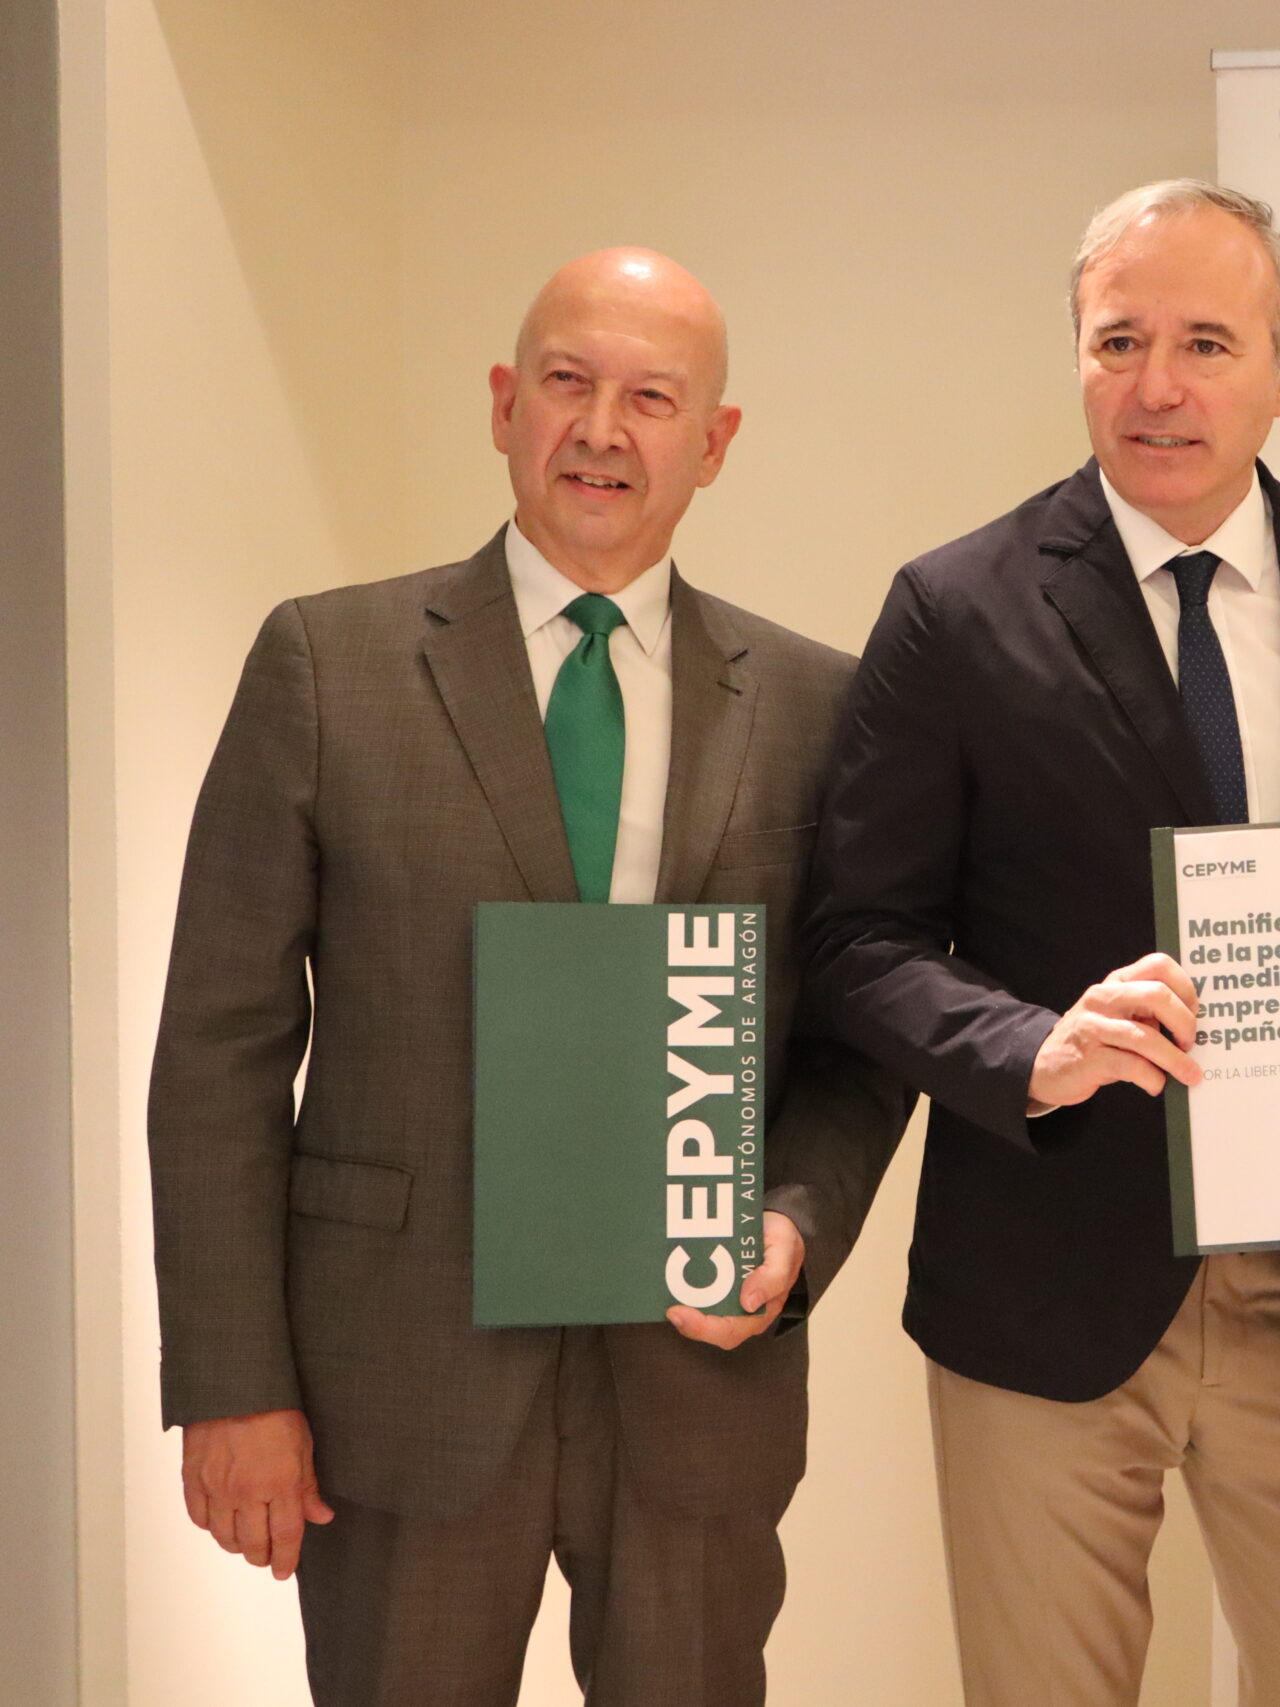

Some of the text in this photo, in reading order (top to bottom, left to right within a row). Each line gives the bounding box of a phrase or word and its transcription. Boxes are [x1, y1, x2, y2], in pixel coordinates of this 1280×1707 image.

[1182, 859, 1256, 878] CEPYME
[1190, 945, 1221, 965] de
[1228, 943, 1251, 962] la
[1191, 975, 1207, 997] y
[1203, 1069, 1221, 1081] OR
[1226, 1067, 1241, 1079] LA
[738, 913, 757, 1279] MES Y AUTÓNOMOS DE ARAGÓN
[665, 913, 735, 1308] CEPYME
